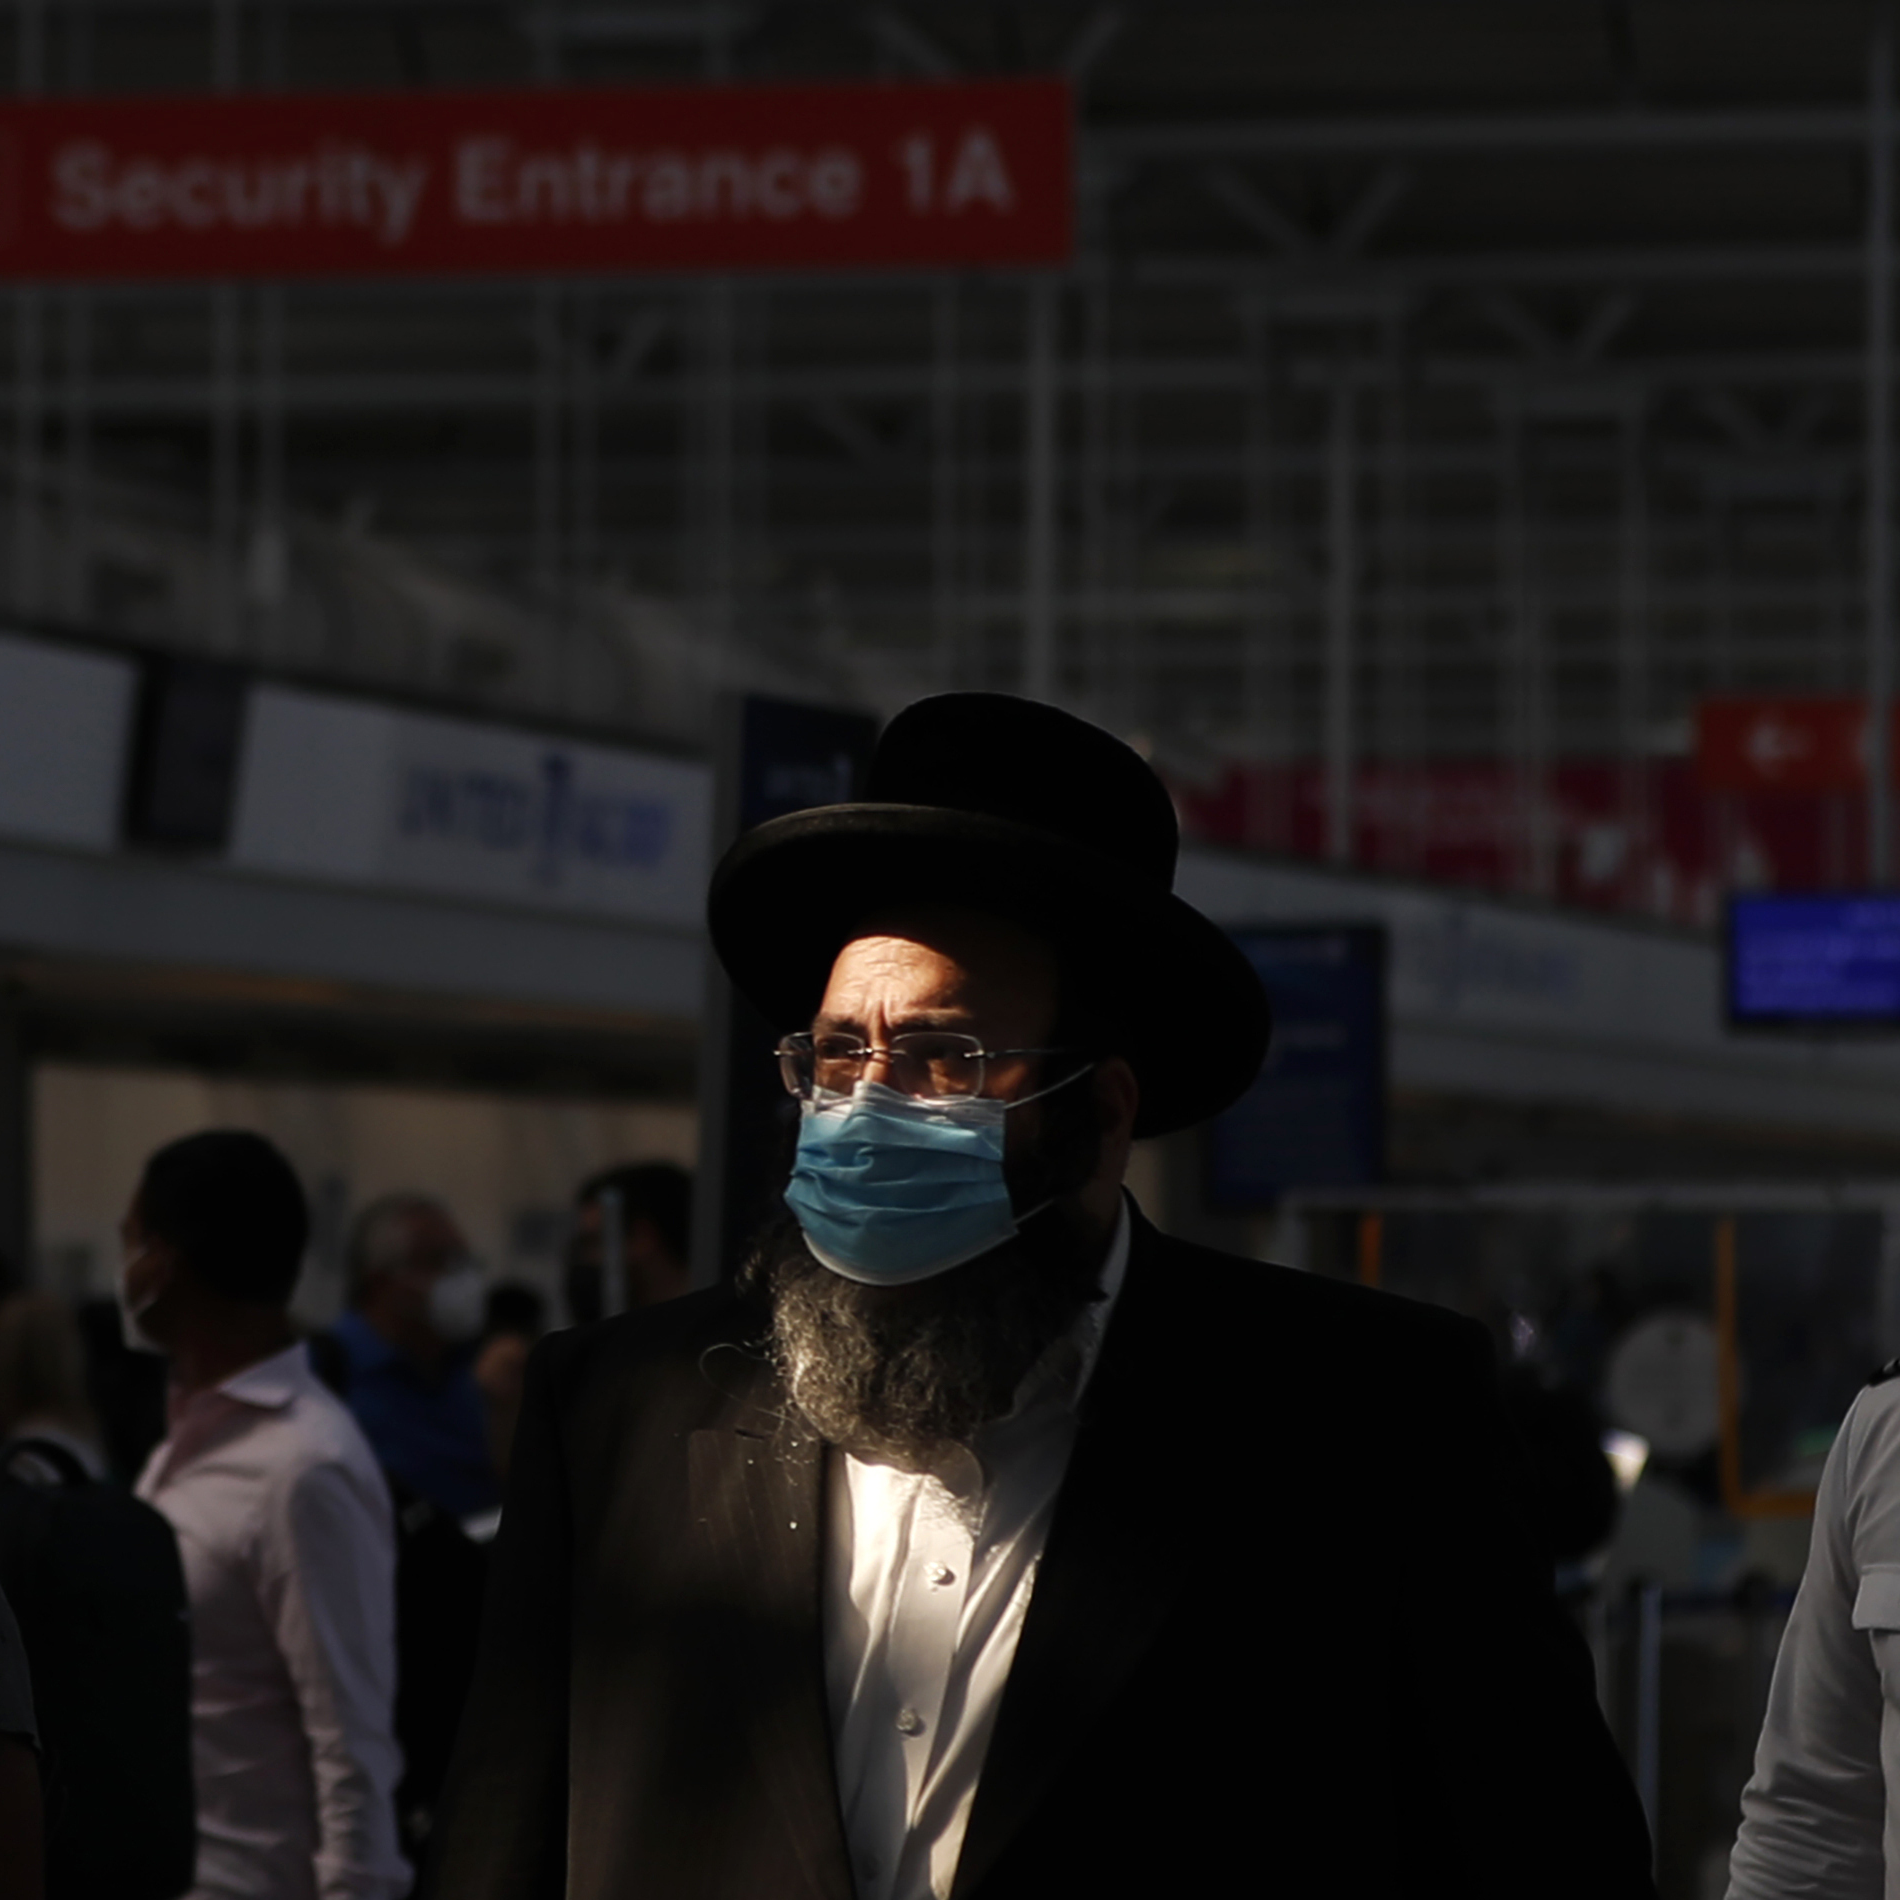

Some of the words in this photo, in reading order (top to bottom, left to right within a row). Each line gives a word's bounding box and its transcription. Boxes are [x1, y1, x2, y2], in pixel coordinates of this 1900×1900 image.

[51, 136, 424, 248] Security
[452, 132, 863, 226] Entrance
[889, 124, 1014, 219] 1A
